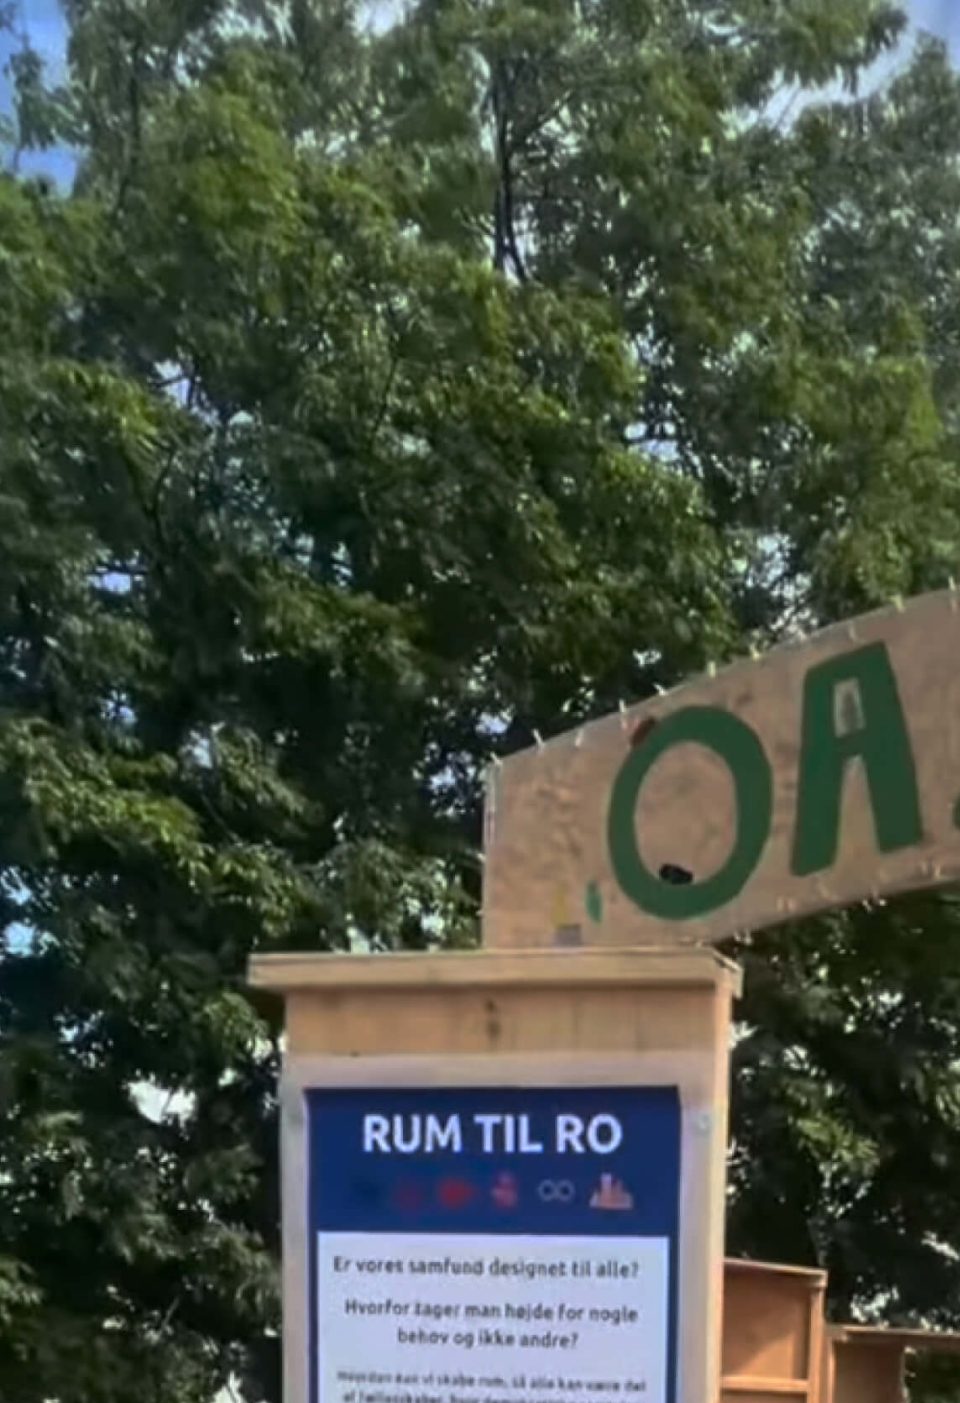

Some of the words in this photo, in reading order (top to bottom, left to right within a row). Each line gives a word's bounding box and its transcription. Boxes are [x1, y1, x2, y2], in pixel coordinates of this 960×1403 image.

[363, 1113, 462, 1153] RUM
[473, 1113, 544, 1153] TIL
[556, 1112, 623, 1154] RO
[333, 1255, 350, 1273] Er
[356, 1259, 404, 1274] vores
[408, 1257, 485, 1276] samfund
[489, 1256, 567, 1280] designet
[571, 1260, 592, 1277] til
[597, 1259, 639, 1279] alle?
[344, 1298, 411, 1315] Hvorfor
[414, 1302, 460, 1320] tager
[464, 1304, 501, 1317] man
[505, 1302, 554, 1322] højde
[558, 1303, 585, 1321] for
[588, 1304, 639, 1326] nogle
[397, 1326, 450, 1345] behov
[452, 1331, 475, 1349] og
[478, 1328, 516, 1347] ikke
[519, 1331, 579, 1348] andre?
